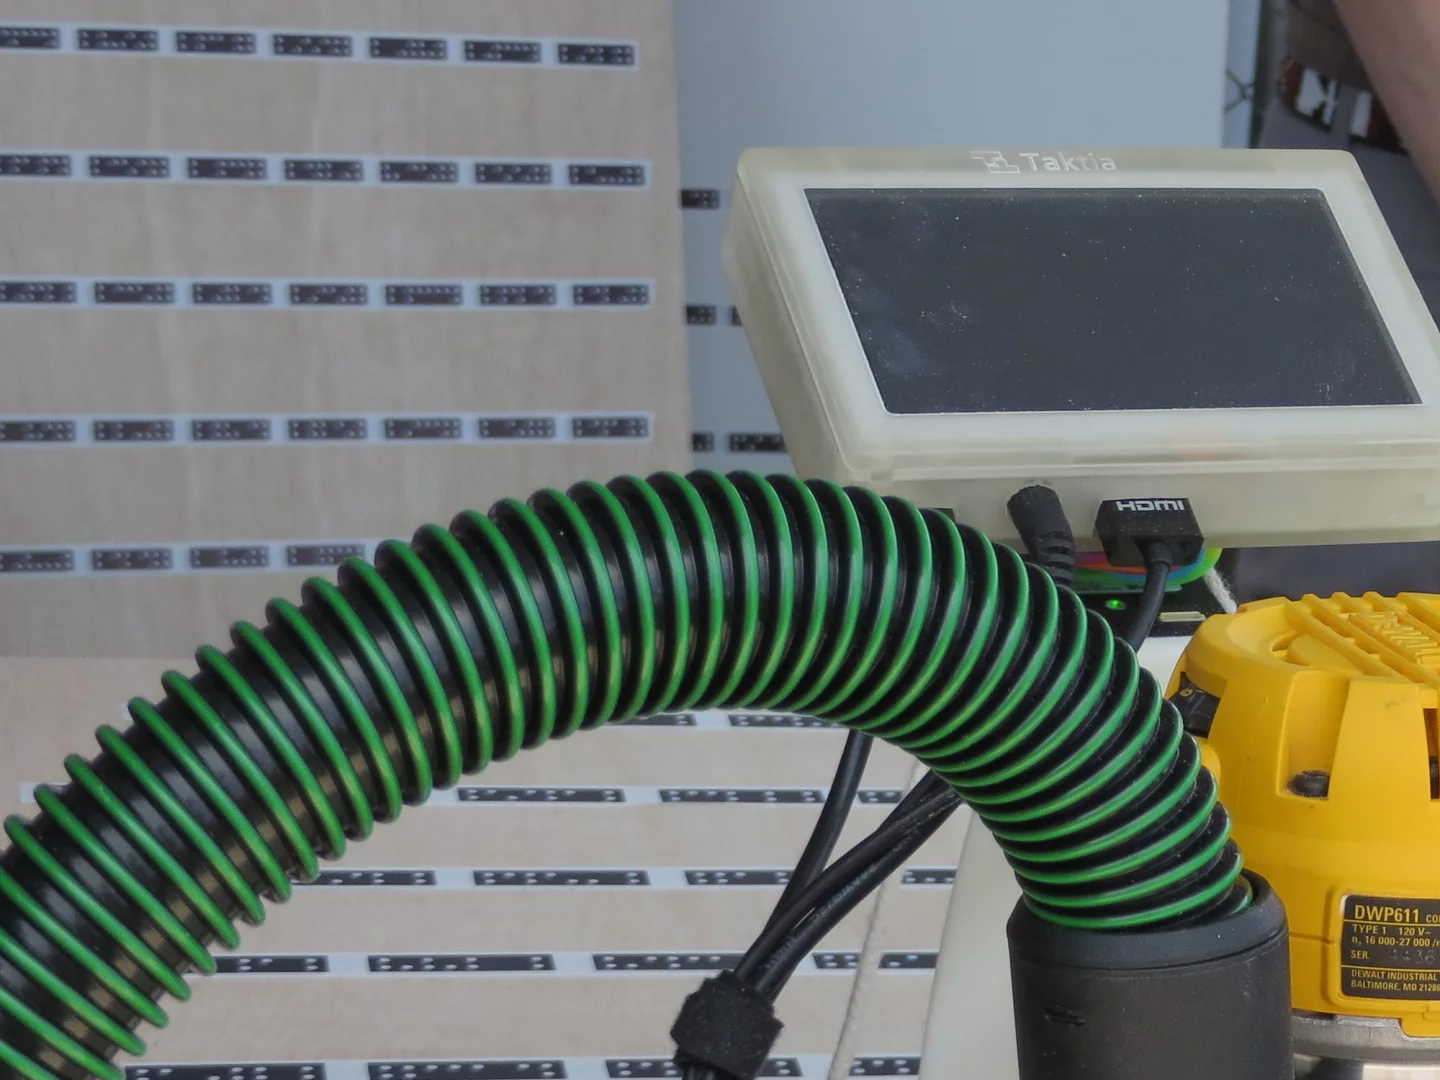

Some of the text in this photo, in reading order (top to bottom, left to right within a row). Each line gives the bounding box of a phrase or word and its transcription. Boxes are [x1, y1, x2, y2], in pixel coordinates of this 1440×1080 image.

[1018, 151, 1118, 172] Taktia
[1115, 499, 1186, 512] HDMI
[1354, 904, 1420, 923] DWP611
[1352, 923, 1379, 934] TYPE
[1382, 926, 1388, 935] 1
[1399, 926, 1415, 936] 120
[1365, 935, 1376, 945] 16
[1378, 936, 1411, 947] 000-27
[1413, 938, 1431, 948] 000
[1350, 949, 1371, 960] SER.
[1351, 969, 1386, 980] DEWALT
[1387, 971, 1438, 981] INDUSTRIAL
[1402, 982, 1418, 991] MD
